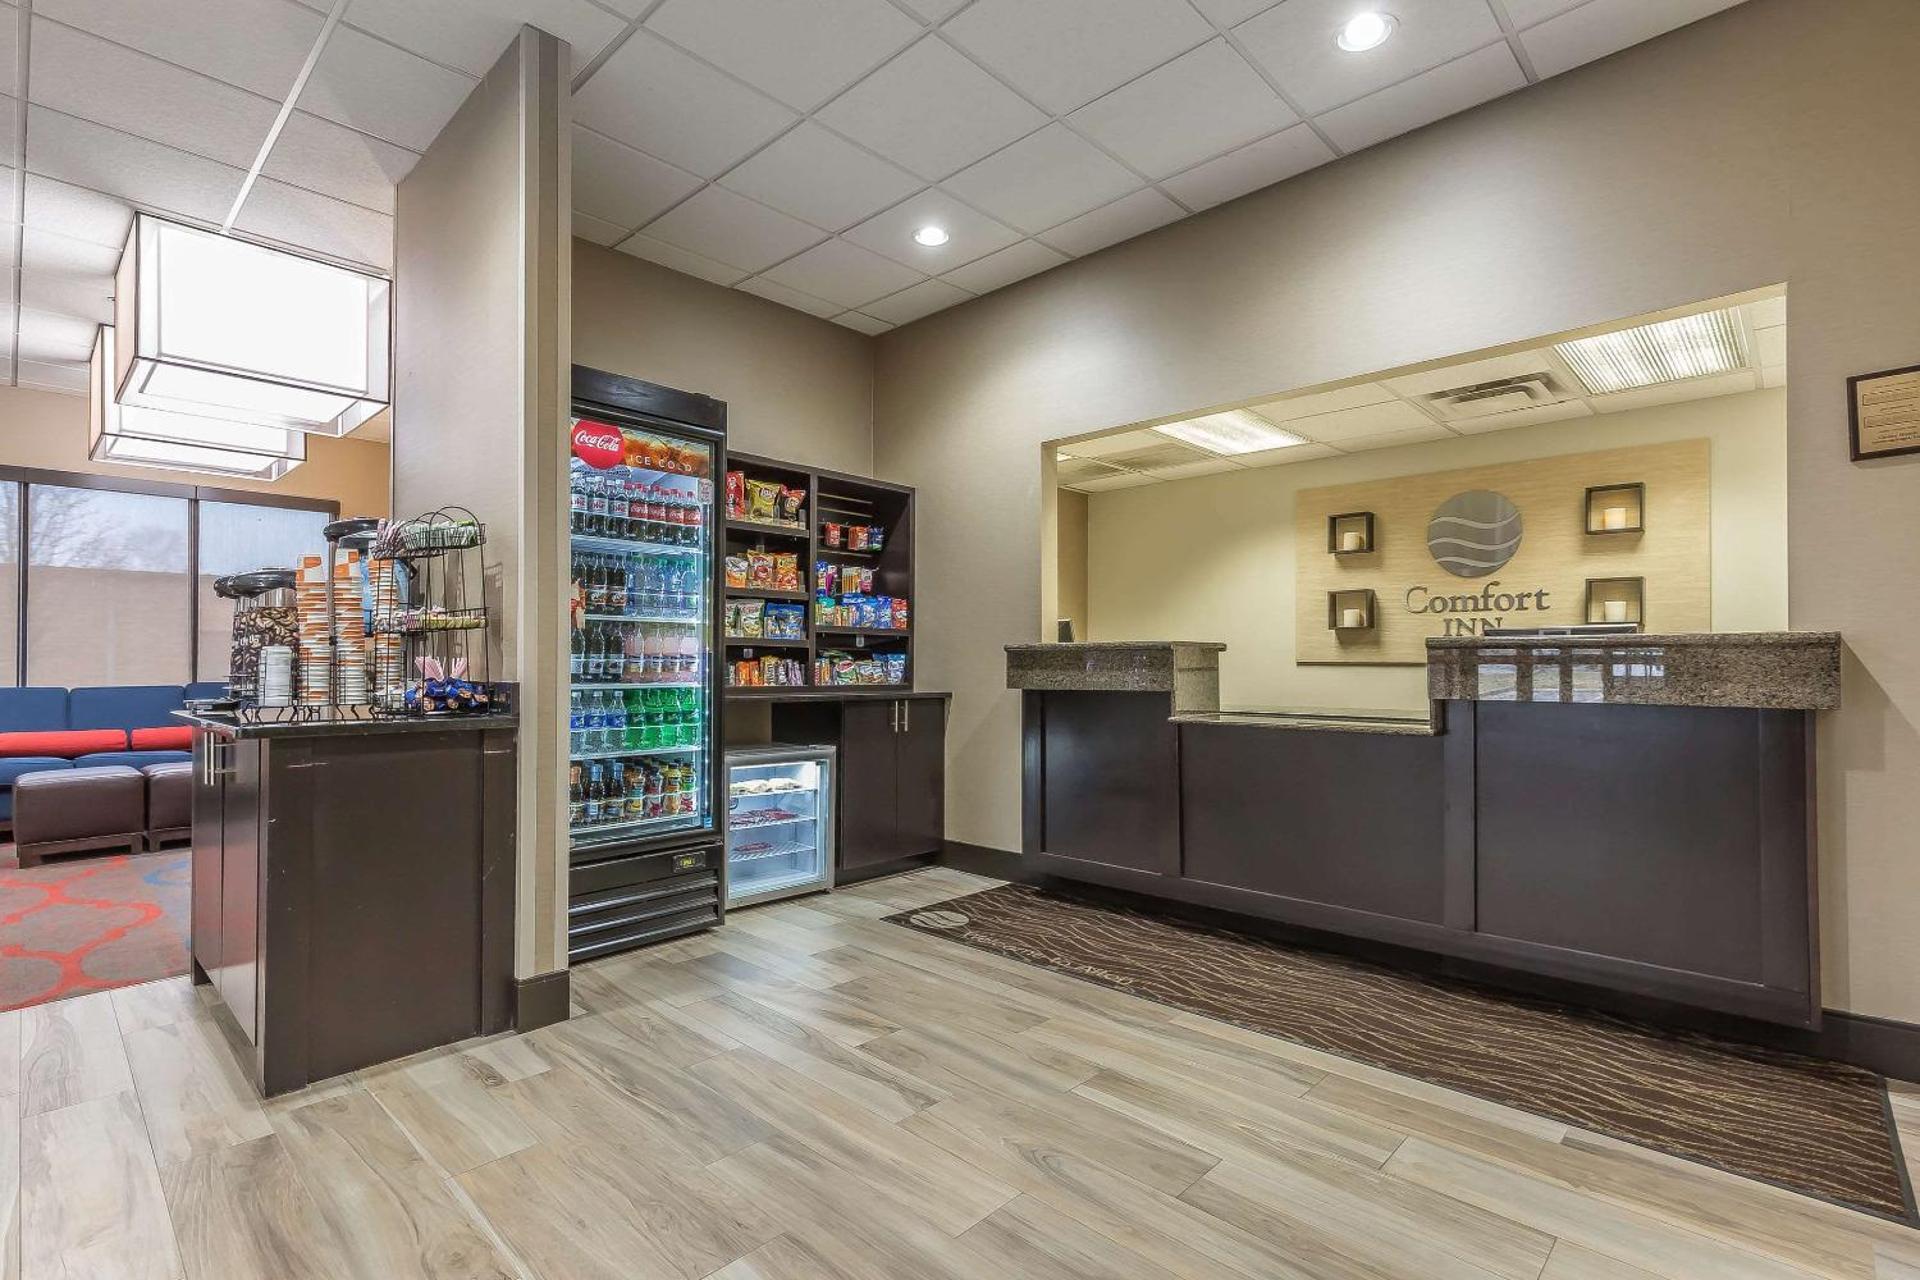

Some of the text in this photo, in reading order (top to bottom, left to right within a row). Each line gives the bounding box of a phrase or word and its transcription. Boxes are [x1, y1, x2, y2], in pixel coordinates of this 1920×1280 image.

[629, 455, 651, 466] ICE
[1406, 580, 1551, 614] Comfort
[1443, 617, 1503, 637] INN
